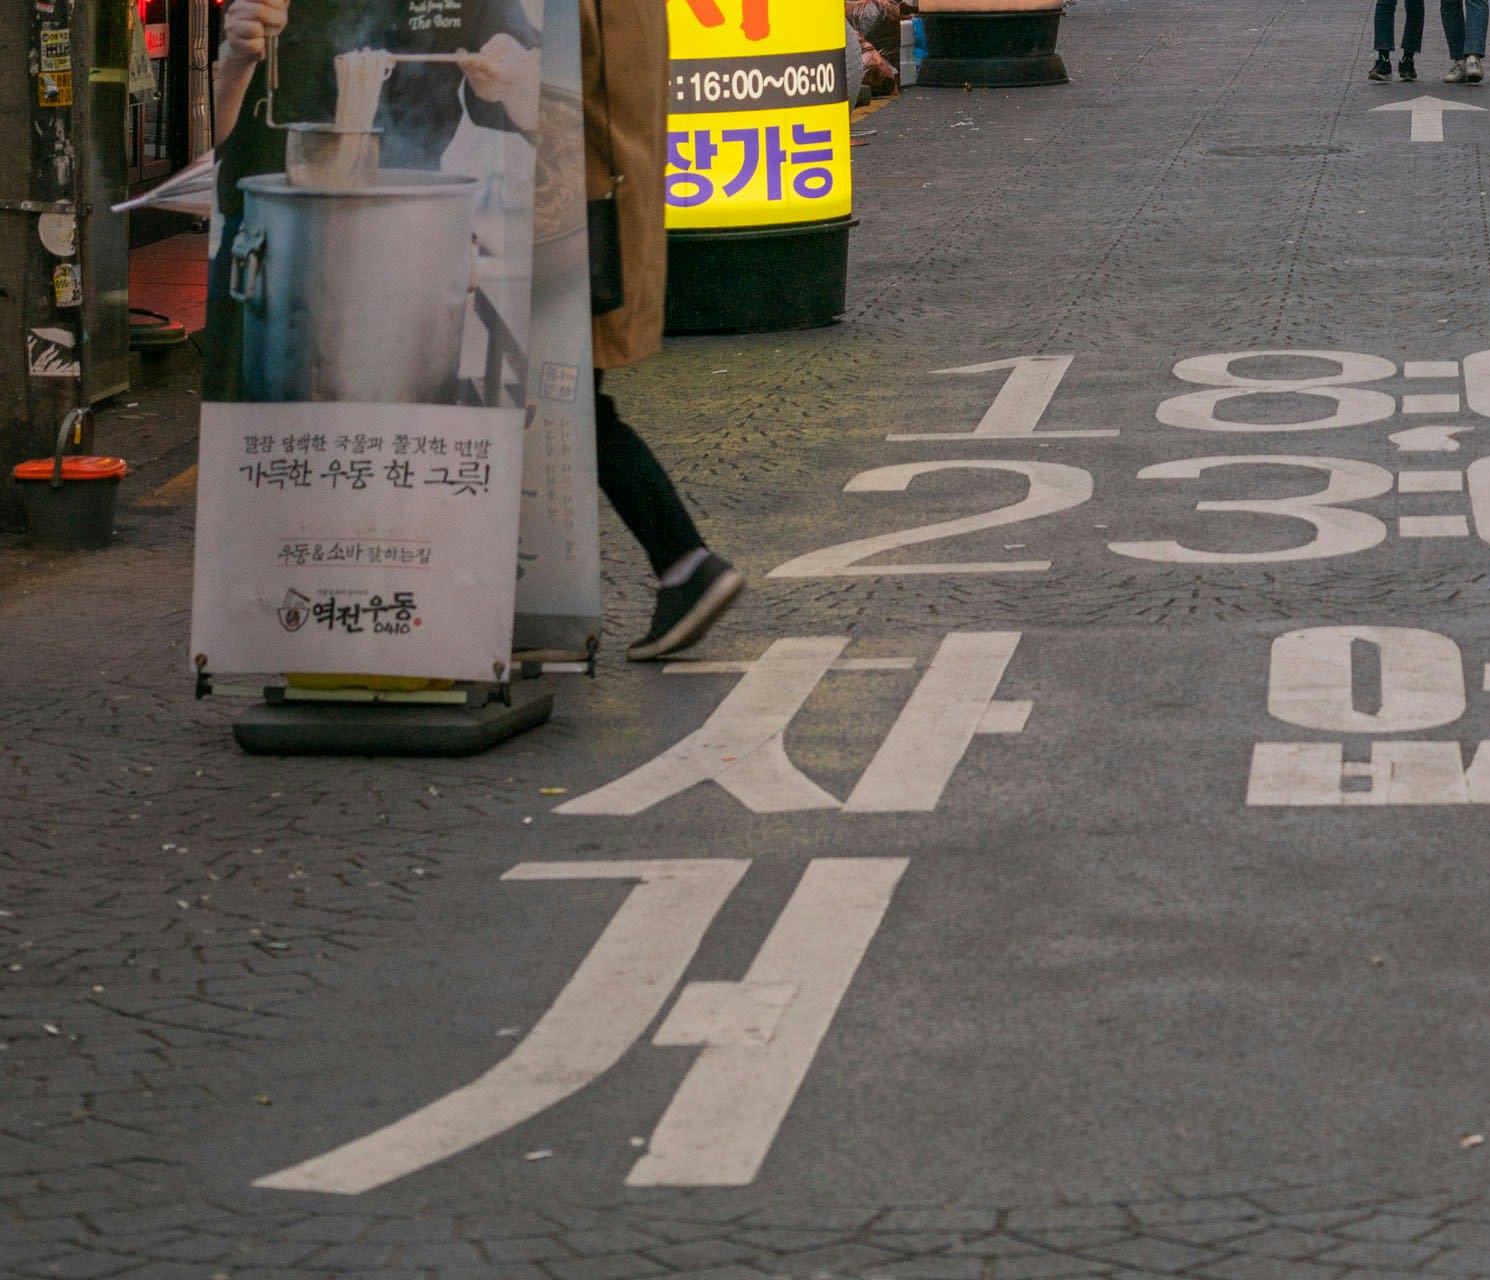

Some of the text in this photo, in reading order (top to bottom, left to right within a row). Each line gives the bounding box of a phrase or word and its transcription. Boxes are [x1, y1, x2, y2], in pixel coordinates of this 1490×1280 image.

[239, 459, 492, 497] 가득한 우동 한 그릇!
[312, 591, 417, 635] 역전우동
[372, 621, 411, 635] 0410
[554, 633, 1034, 814] 차
